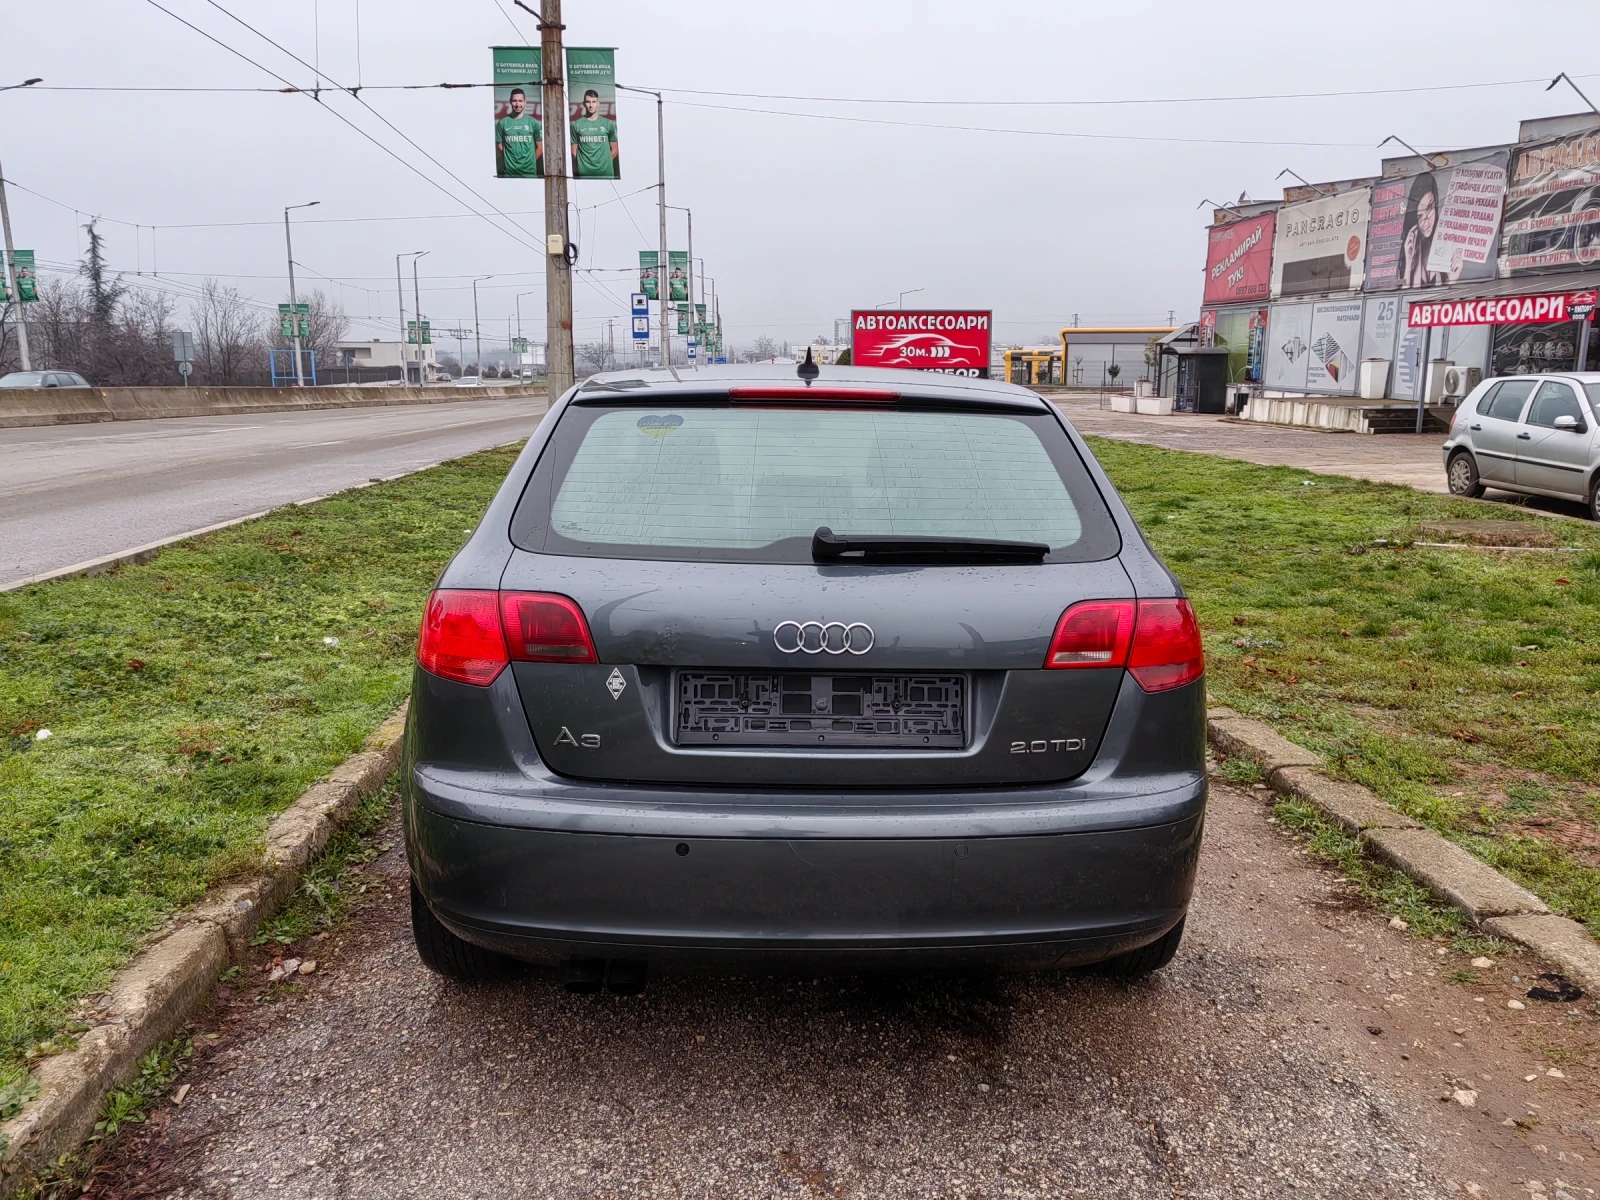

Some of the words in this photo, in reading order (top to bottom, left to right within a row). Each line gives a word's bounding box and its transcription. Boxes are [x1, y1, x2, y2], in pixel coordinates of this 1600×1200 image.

[505, 135, 532, 143] WINBET
[579, 135, 607, 143] WINBET
[1483, 170, 1504, 180] УСЛУГИ
[1455, 181, 1481, 193] ГРАФИЧЕН
[1481, 182, 1503, 194] ДИЗАЙН
[1453, 195, 1475, 206] ПЕЧАТНА
[1475, 197, 1499, 209] РЕКЛАМА
[1449, 207, 1471, 219] ВЪНШНА
[1470, 209, 1495, 222] РЕКЛАМА
[1285, 208, 1360, 238] PANCRACIO
[1443, 220, 1469, 231] РЕКЛАМНИ
[1469, 223, 1494, 236] СУВЕНИРИ
[1299, 240, 1315, 248] ARTISAN
[1315, 235, 1339, 245] CHOCOLATE
[1443, 232, 1467, 244] ФИРМЕНИ
[1467, 236, 1488, 248] ПЕЧАТИ
[1211, 224, 1262, 281] РЕКЛАМИРАЙ
[1464, 249, 1486, 261] ТЕНИСКИ
[1228, 265, 1245, 288] ТУК!
[1377, 301, 1395, 321] 25
[1410, 296, 1564, 325] АВТОАКСЕСОАРИ
[855, 315, 988, 330] АВТОАКСЕСОАРИ
[899, 346, 929, 357] 30м.
[553, 726, 601, 748] A3
[1009, 740, 1048, 754] 2.0
[1050, 738, 1086, 752] TDI
